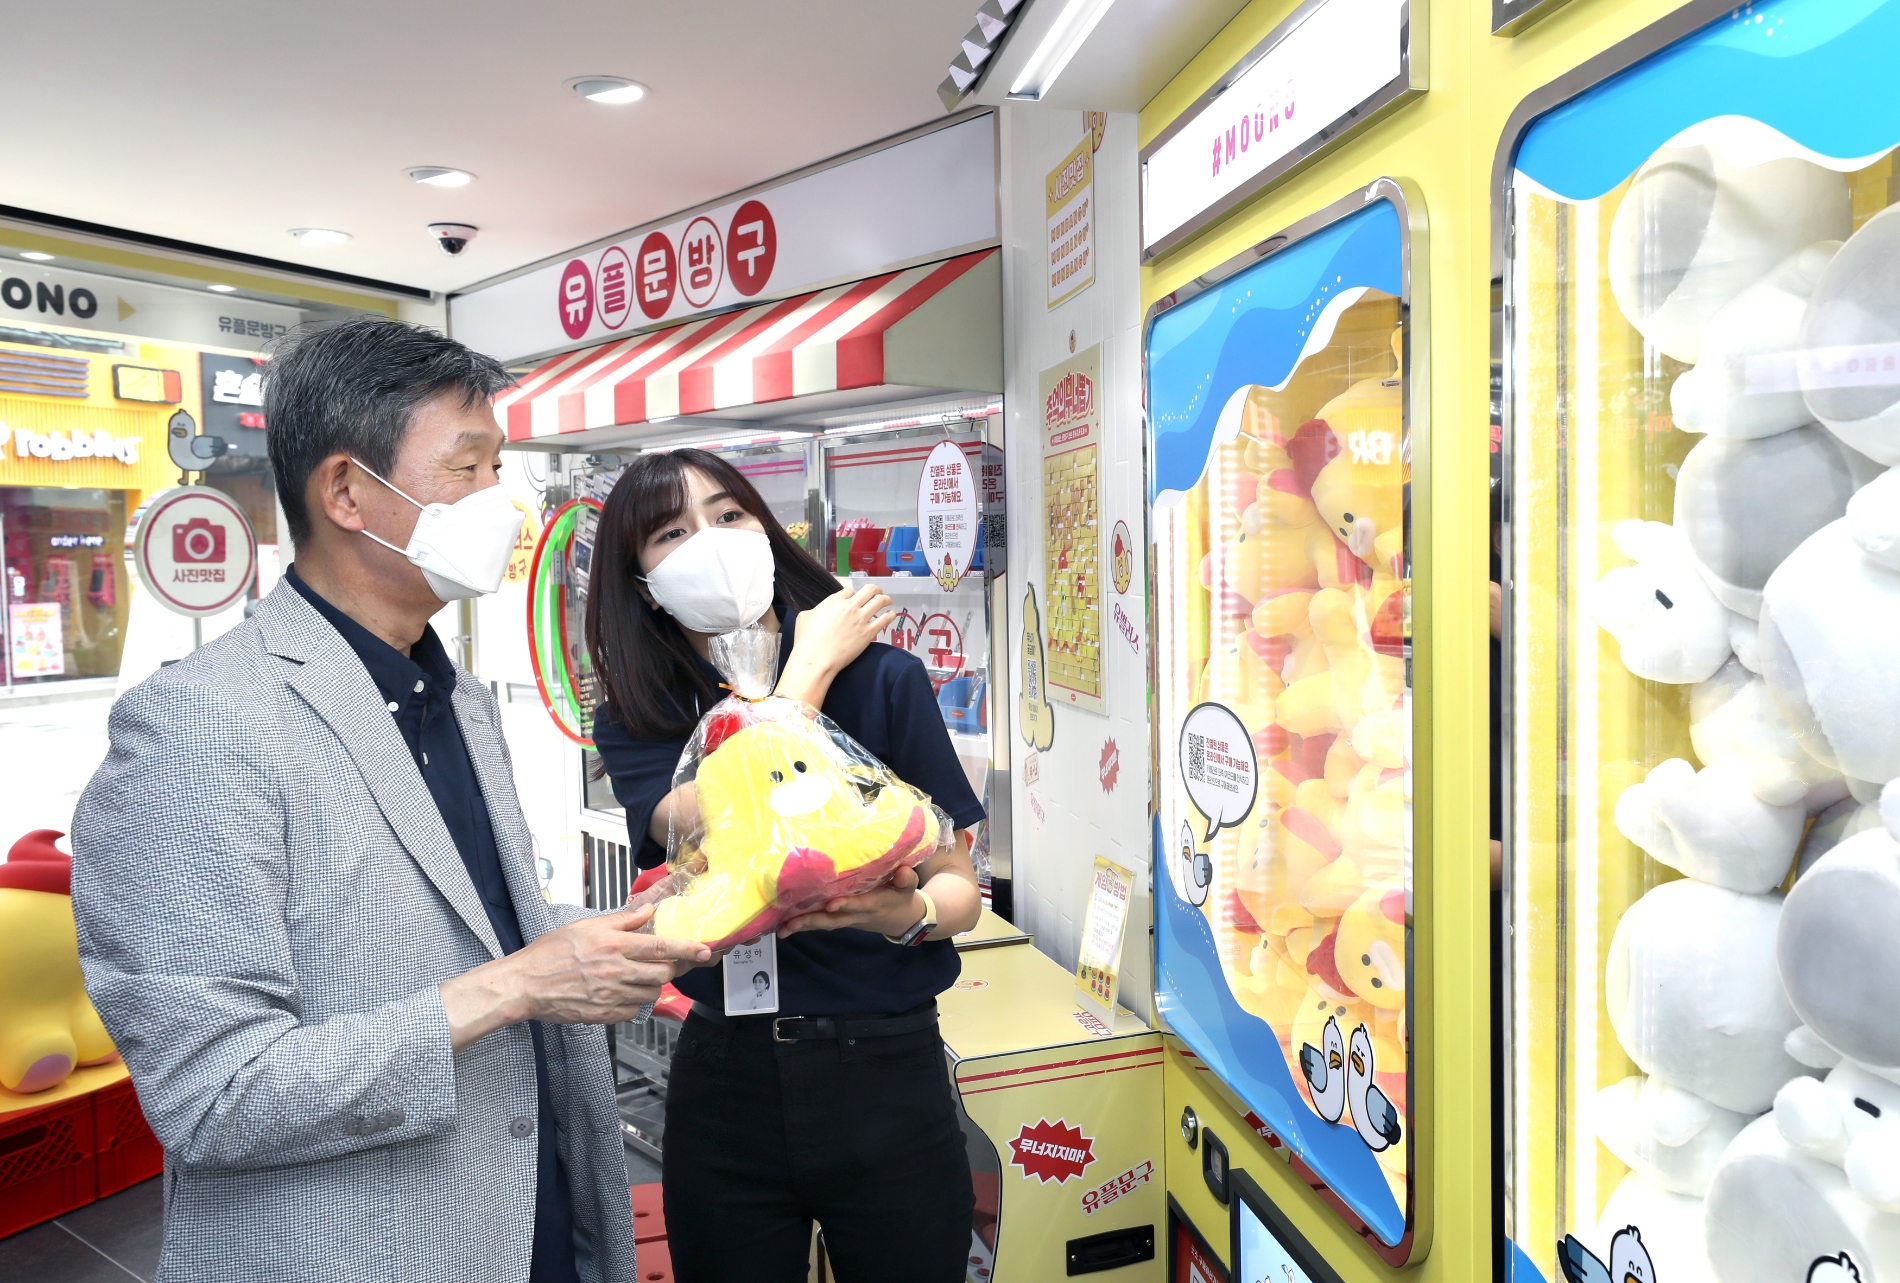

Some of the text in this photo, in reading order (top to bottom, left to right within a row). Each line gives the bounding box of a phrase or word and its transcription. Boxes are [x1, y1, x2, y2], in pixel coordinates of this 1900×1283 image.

[1054, 151, 1084, 203] 사진맛집
[565, 219, 766, 325] 유플문방구
[1, 277, 97, 319] ONO
[930, 463, 962, 478] 진열된 상품은
[933, 477, 959, 491] 온라인에서
[930, 491, 963, 504] 구매 가능해요.
[172, 569, 226, 583] 사진맛집
[1206, 737, 1218, 750] 진열된
[1206, 750, 1225, 765] 온라인에서
[1225, 755, 1232, 768] 구매
[1113, 879, 1128, 901] 방법
[733, 948, 762, 959] 유성하
[1019, 1138, 1087, 1164] 무너지지마!
[1081, 1160, 1155, 1214] 유플문구
